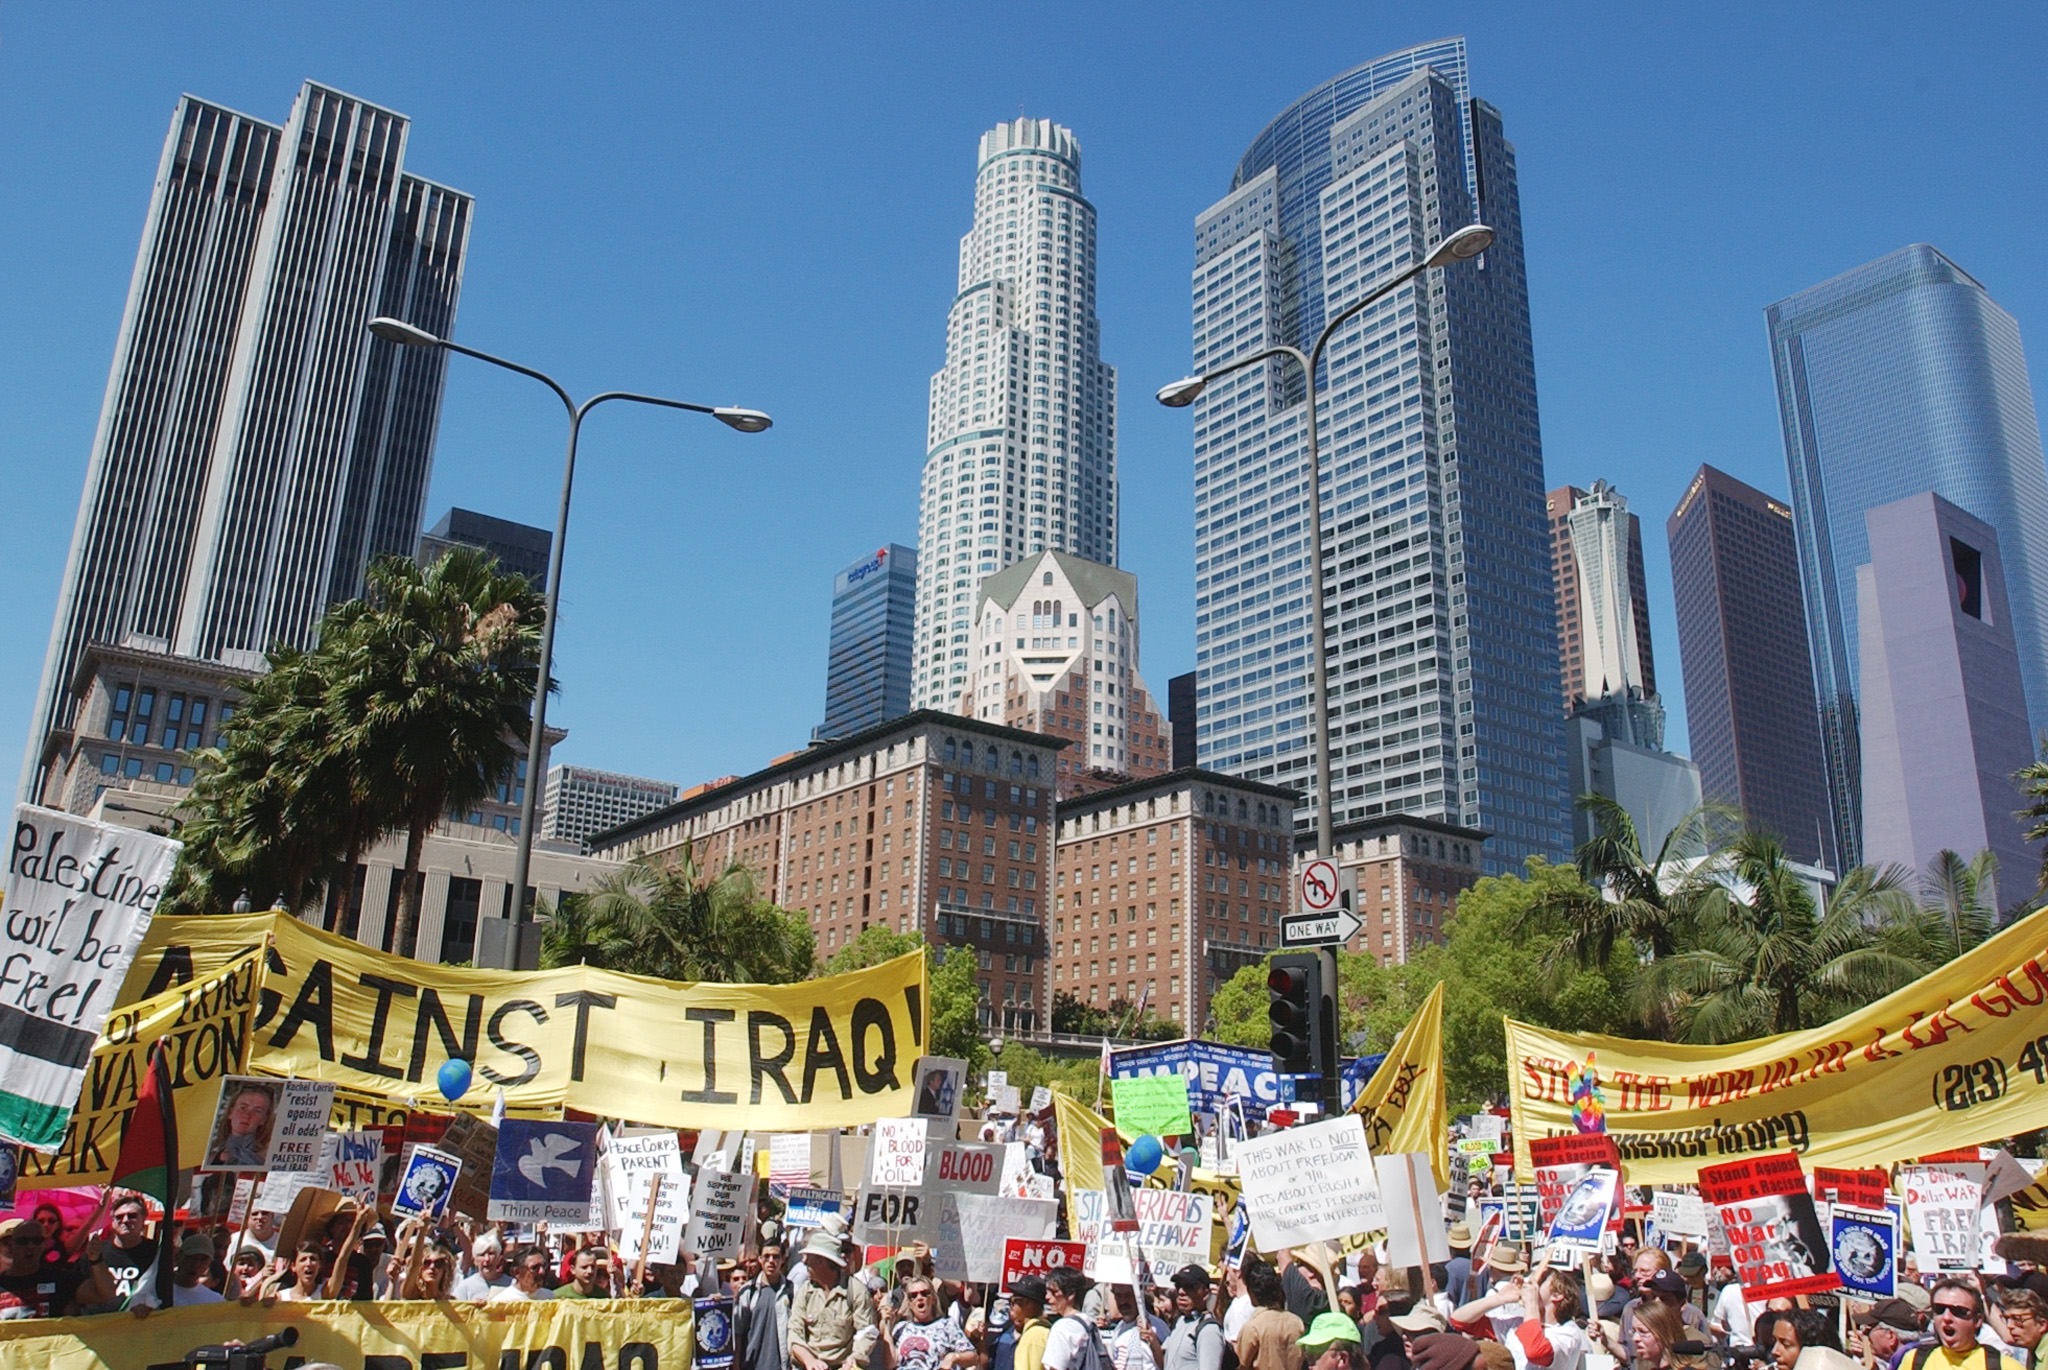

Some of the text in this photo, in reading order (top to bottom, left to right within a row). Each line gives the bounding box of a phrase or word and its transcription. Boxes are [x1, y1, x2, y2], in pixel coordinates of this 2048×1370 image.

[8, 820, 161, 912] Palestine
[76, 909, 122, 969] be
[1289, 920, 1339, 938] ONE WAY
[107, 1004, 156, 1045] OF
[141, 946, 922, 1106] AGAINST IRAQ!
[1613, 1071, 1672, 1111] THE
[1932, 1057, 2007, 1111] (213)
[882, 1126, 896, 1137] NO
[279, 1142, 312, 1153] FREE
[642, 1137, 678, 1153] CORPS
[888, 1140, 923, 1153] BLOOD
[1243, 1147, 1272, 1165] THIS
[1274, 1140, 1306, 1158] WAR
[1309, 1136, 1323, 1149] IS
[1328, 1128, 1359, 1146] NOT
[621, 1154, 671, 1170] PARENT
[895, 1155, 914, 1167] FOR
[939, 1150, 993, 1182] BLOOD
[1250, 1151, 1359, 1180] ABOUT FREEDOM
[1708, 1156, 1801, 1185] Stand Against
[885, 1169, 911, 1182] OIL
[1903, 1166, 1925, 1187] 75
[1277, 1186, 1316, 1201] ABOUT
[1320, 1178, 1352, 1194] BUSH
[1714, 1187, 1743, 1201] War
[1760, 1175, 1807, 1194] Racism
[1907, 1185, 1978, 1206] Dollar WAR
[500, 1204, 581, 1218] Think Peace
[788, 1207, 823, 1221] WARFA
[864, 1193, 919, 1225] FOR
[1106, 1188, 1204, 1224] ERICA'S
[697, 1233, 732, 1250] NOW!
[1726, 1224, 1776, 1246] War
[1022, 1247, 1066, 1268] NO
[1734, 1245, 1765, 1264] on
[1739, 1261, 1791, 1283] Iraq
